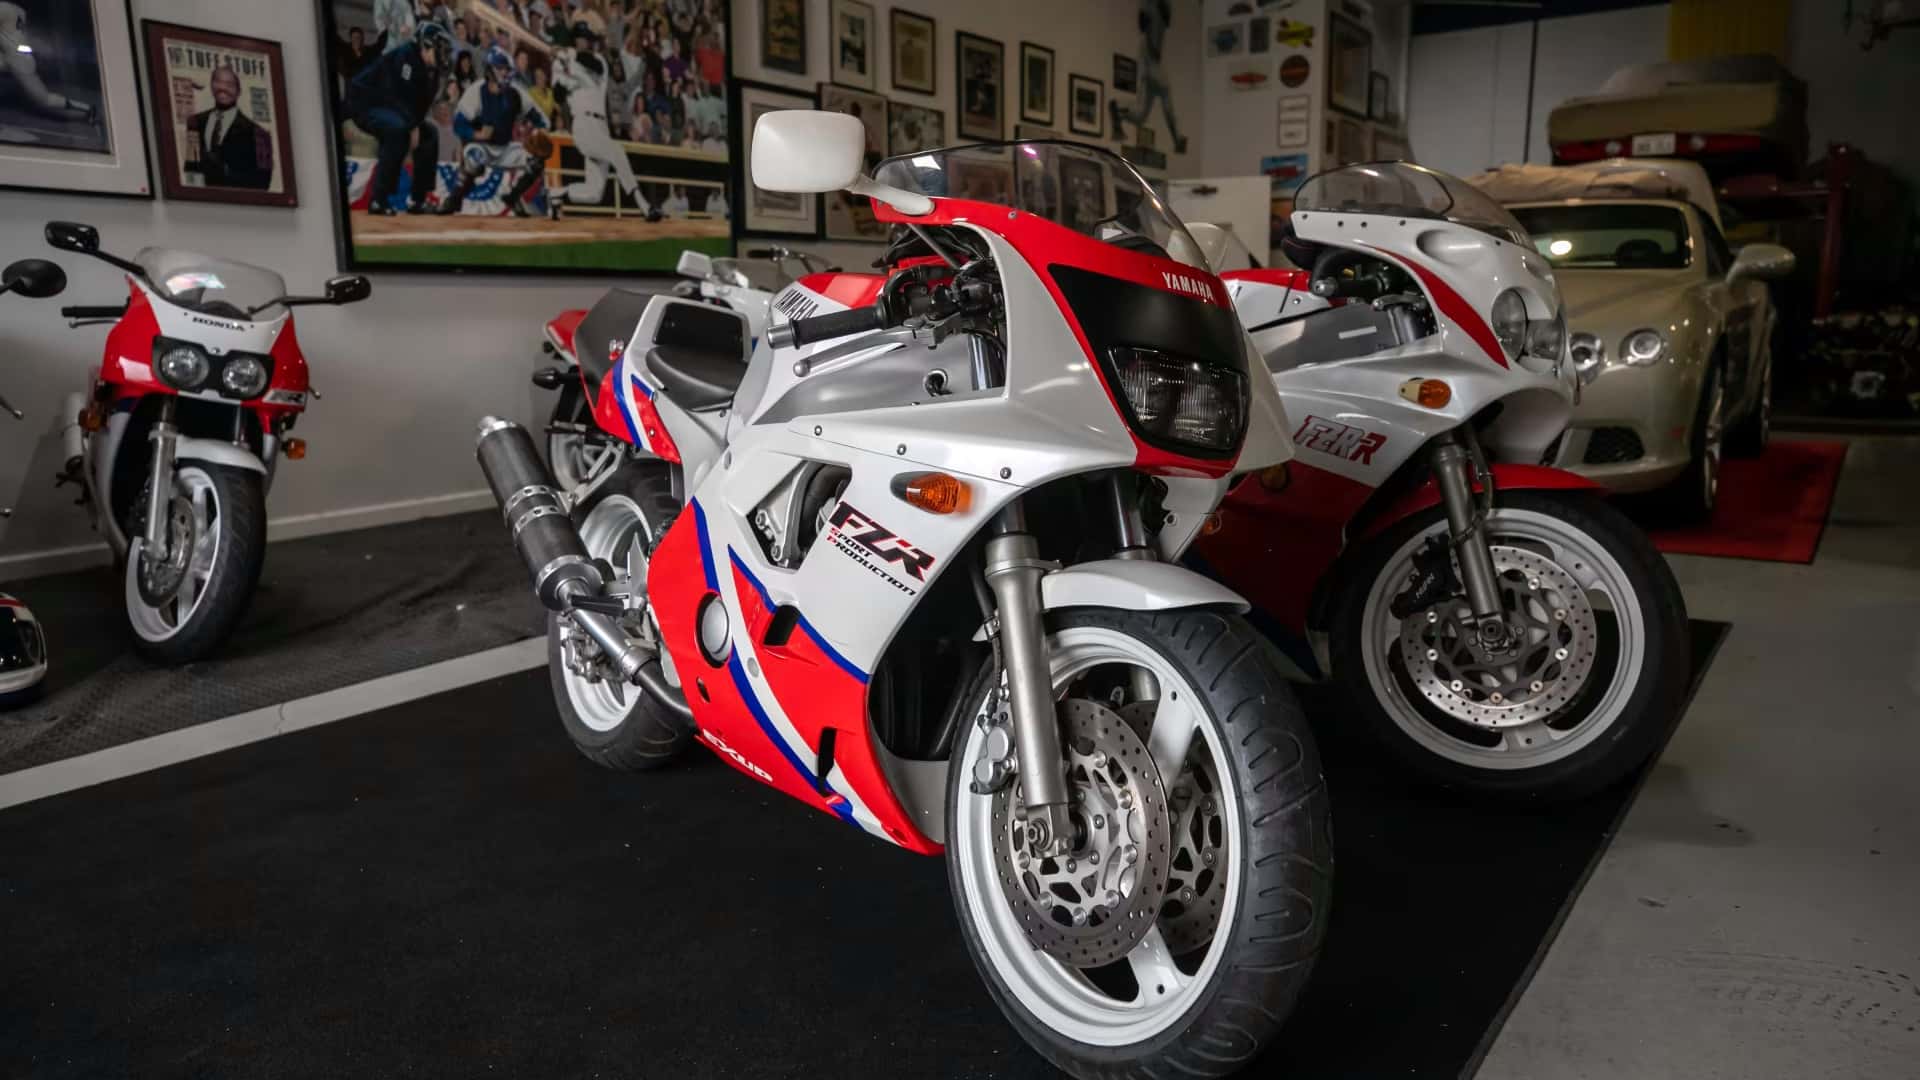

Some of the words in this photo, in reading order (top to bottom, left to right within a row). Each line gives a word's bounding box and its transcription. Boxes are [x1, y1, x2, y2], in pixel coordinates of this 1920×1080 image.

[185, 49, 219, 70] TUFF
[1161, 271, 1214, 301] YAMAHA
[774, 288, 819, 320] YAMAHA
[192, 316, 246, 332] HONDA
[828, 500, 936, 583] FZR
[829, 526, 873, 558] SPORT
[825, 535, 918, 597] PRODUCTION
[702, 727, 774, 783] EXUP
